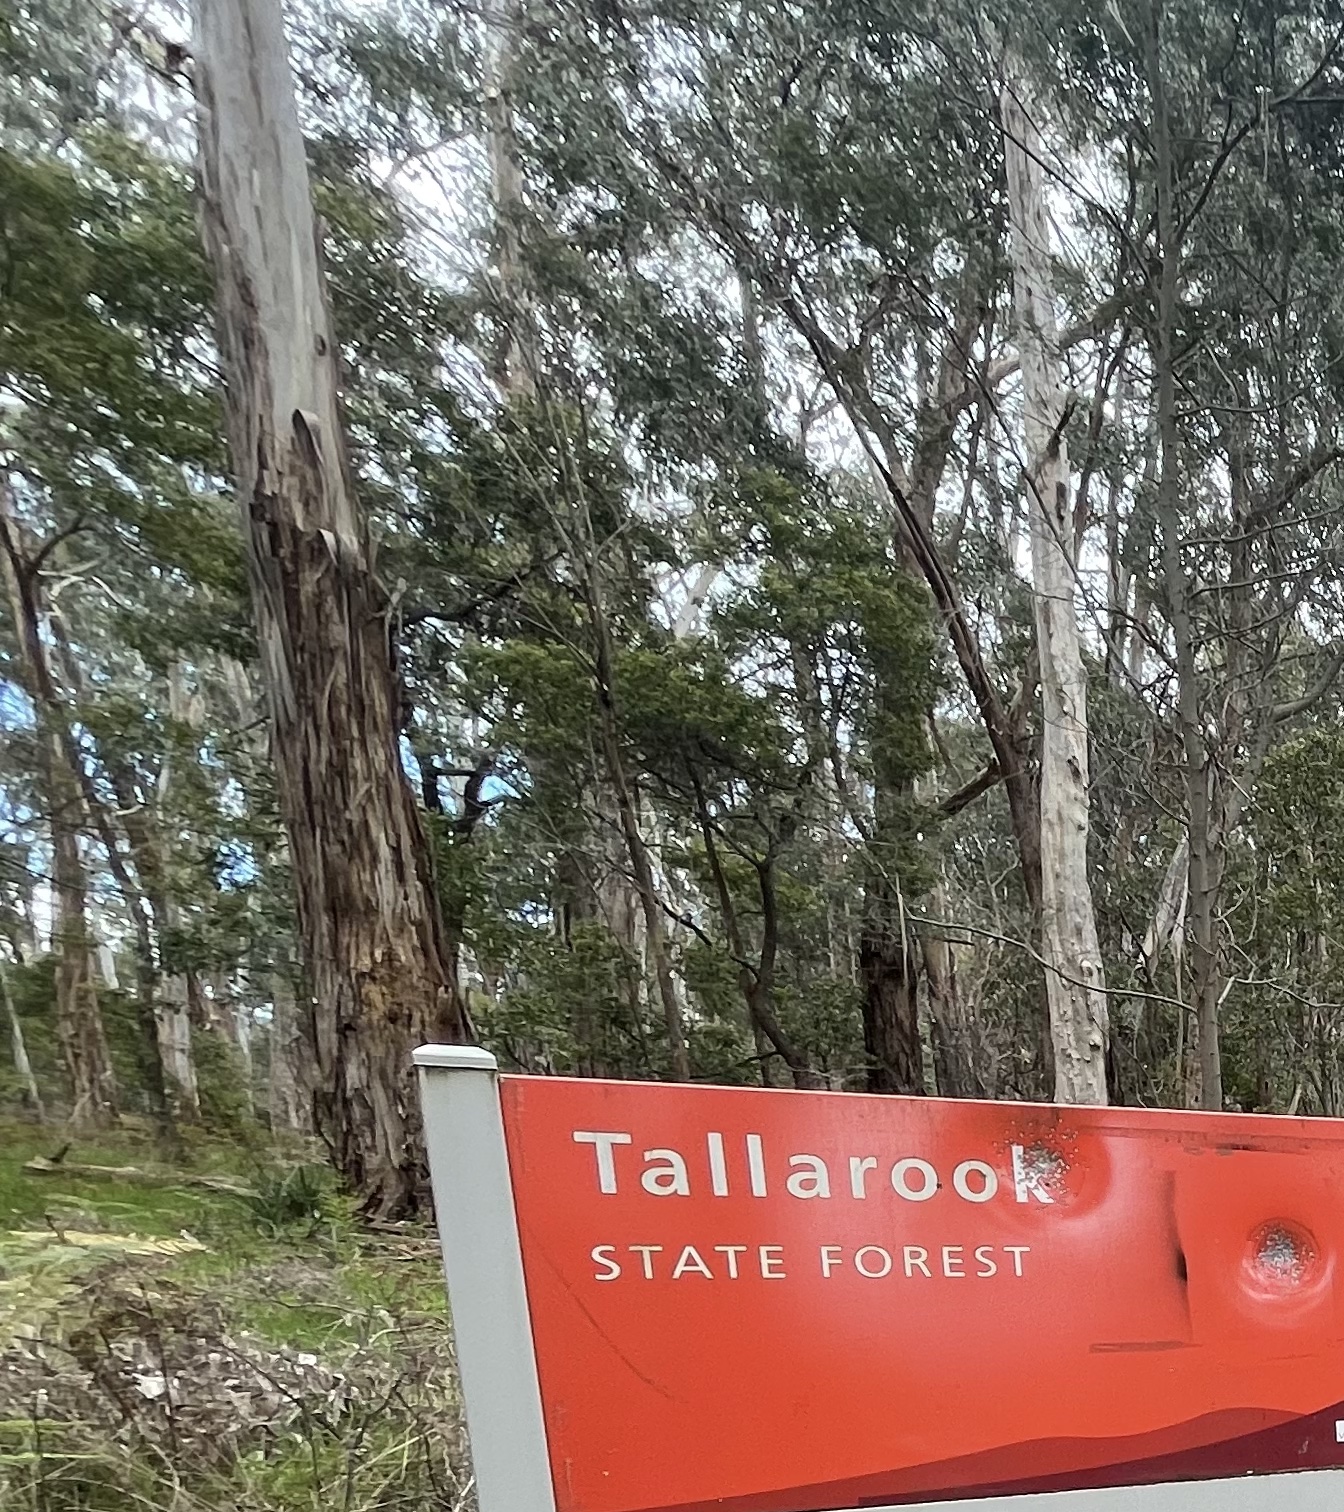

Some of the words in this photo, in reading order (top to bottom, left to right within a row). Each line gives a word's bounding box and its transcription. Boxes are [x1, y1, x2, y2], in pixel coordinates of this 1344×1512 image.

[572, 1131, 1055, 1203] Tallarook
[590, 1244, 787, 1281] STATE
[820, 1244, 1031, 1279] FOREST
